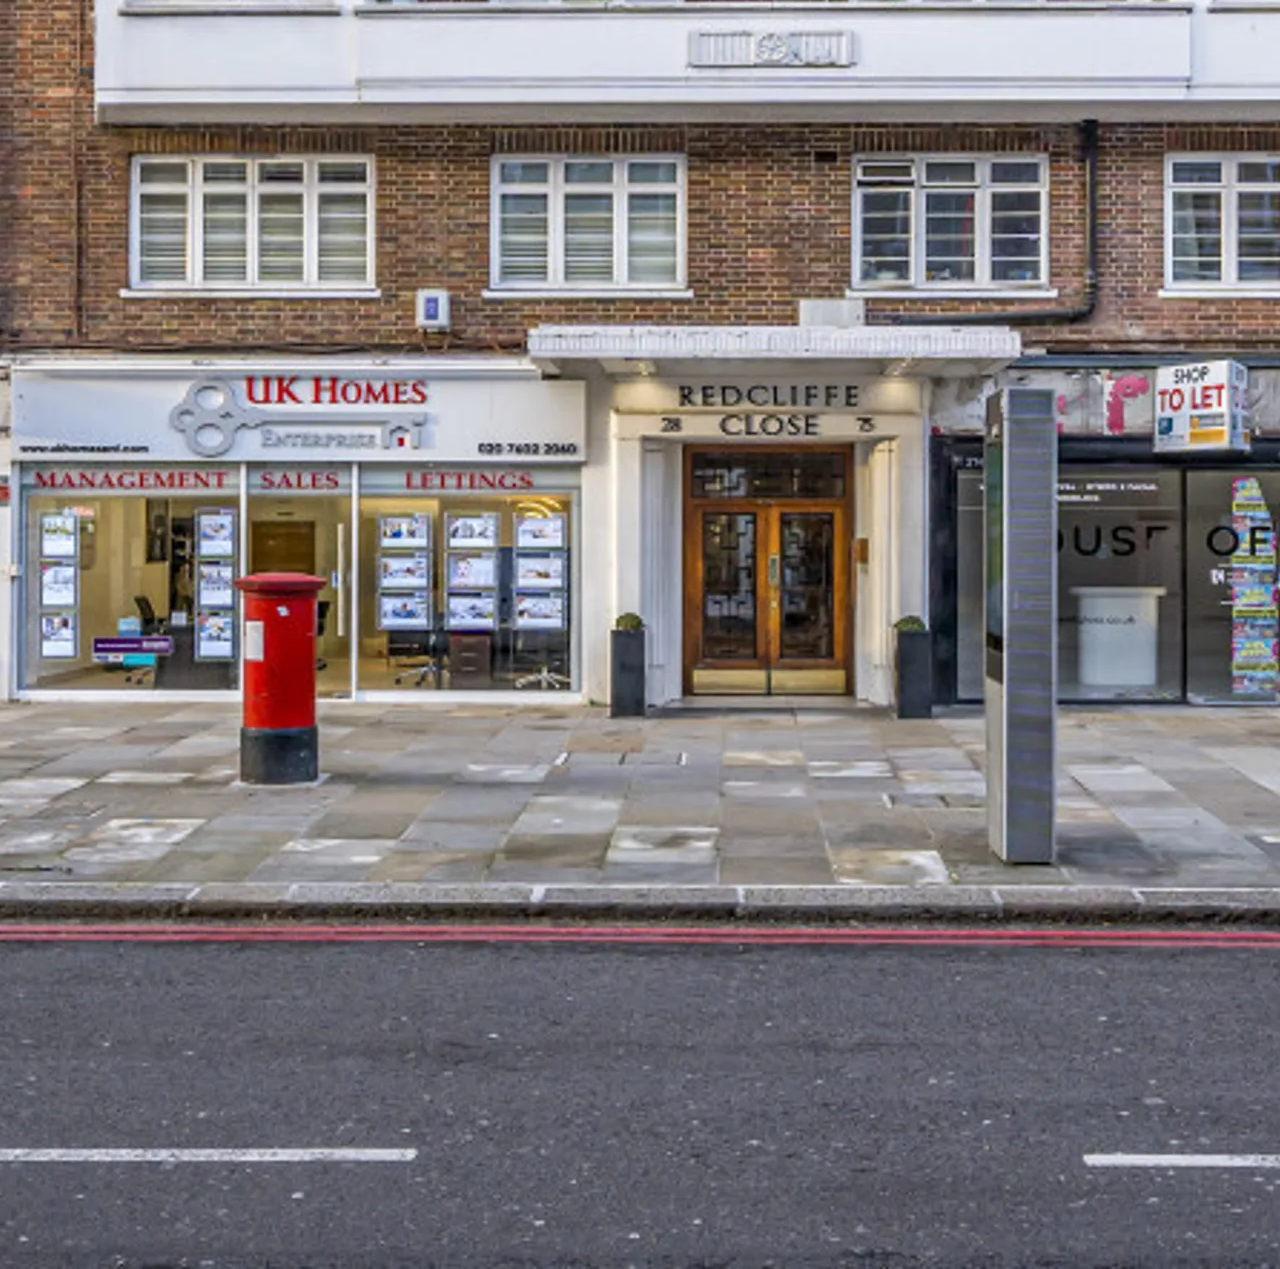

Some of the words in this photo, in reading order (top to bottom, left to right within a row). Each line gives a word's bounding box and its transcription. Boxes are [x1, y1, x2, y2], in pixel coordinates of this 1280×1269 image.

[1174, 366, 1209, 384] SHOP
[245, 376, 302, 404] UK
[312, 376, 428, 404] HOMES
[678, 385, 859, 407] REDCLIFFE
[1158, 388, 1184, 412] TO
[1191, 383, 1225, 409] LET
[661, 417, 683, 433] 28
[720, 415, 820, 437] CLOSE
[478, 443, 502, 454] 020
[35, 471, 228, 489] MANAGEMENT
[261, 471, 339, 489] SALES
[406, 471, 535, 490] LETTINGS
[1207, 526, 1270, 556] OF
